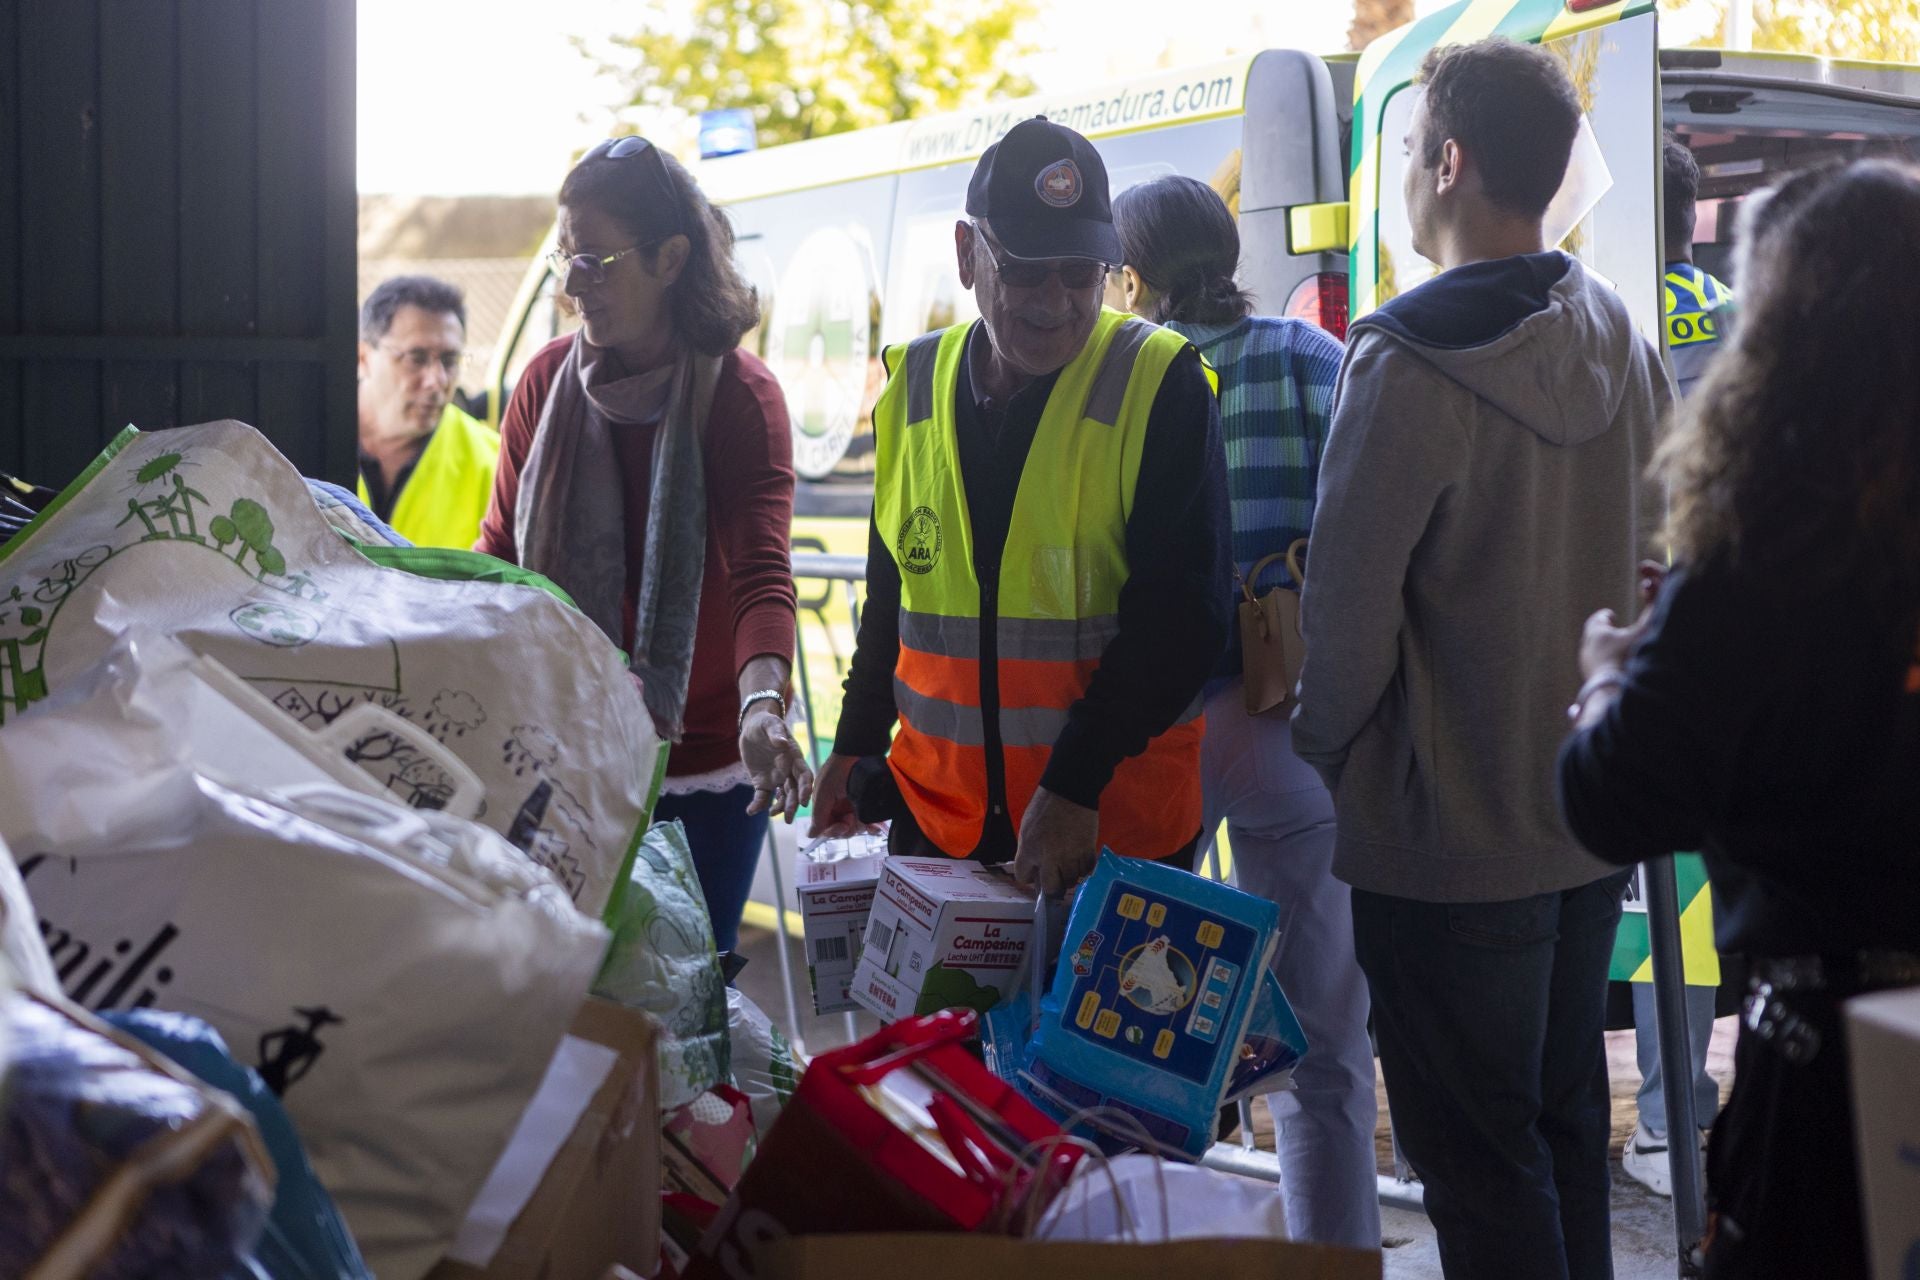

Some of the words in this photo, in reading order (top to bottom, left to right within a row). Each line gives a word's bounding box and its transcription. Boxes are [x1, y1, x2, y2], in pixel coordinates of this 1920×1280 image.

[908, 74, 1233, 162] www.DYAremadura.com
[908, 547, 931, 560] ARA
[812, 895, 826, 905] La
[829, 892, 874, 905] Campes
[885, 873, 895, 887] La
[896, 882, 932, 917] Campesina
[983, 923, 1001, 938] La
[953, 935, 1026, 953] Campesina
[947, 952, 968, 961] Leche
[969, 952, 984, 962] UHT
[868, 981, 897, 1010] ENTERA
